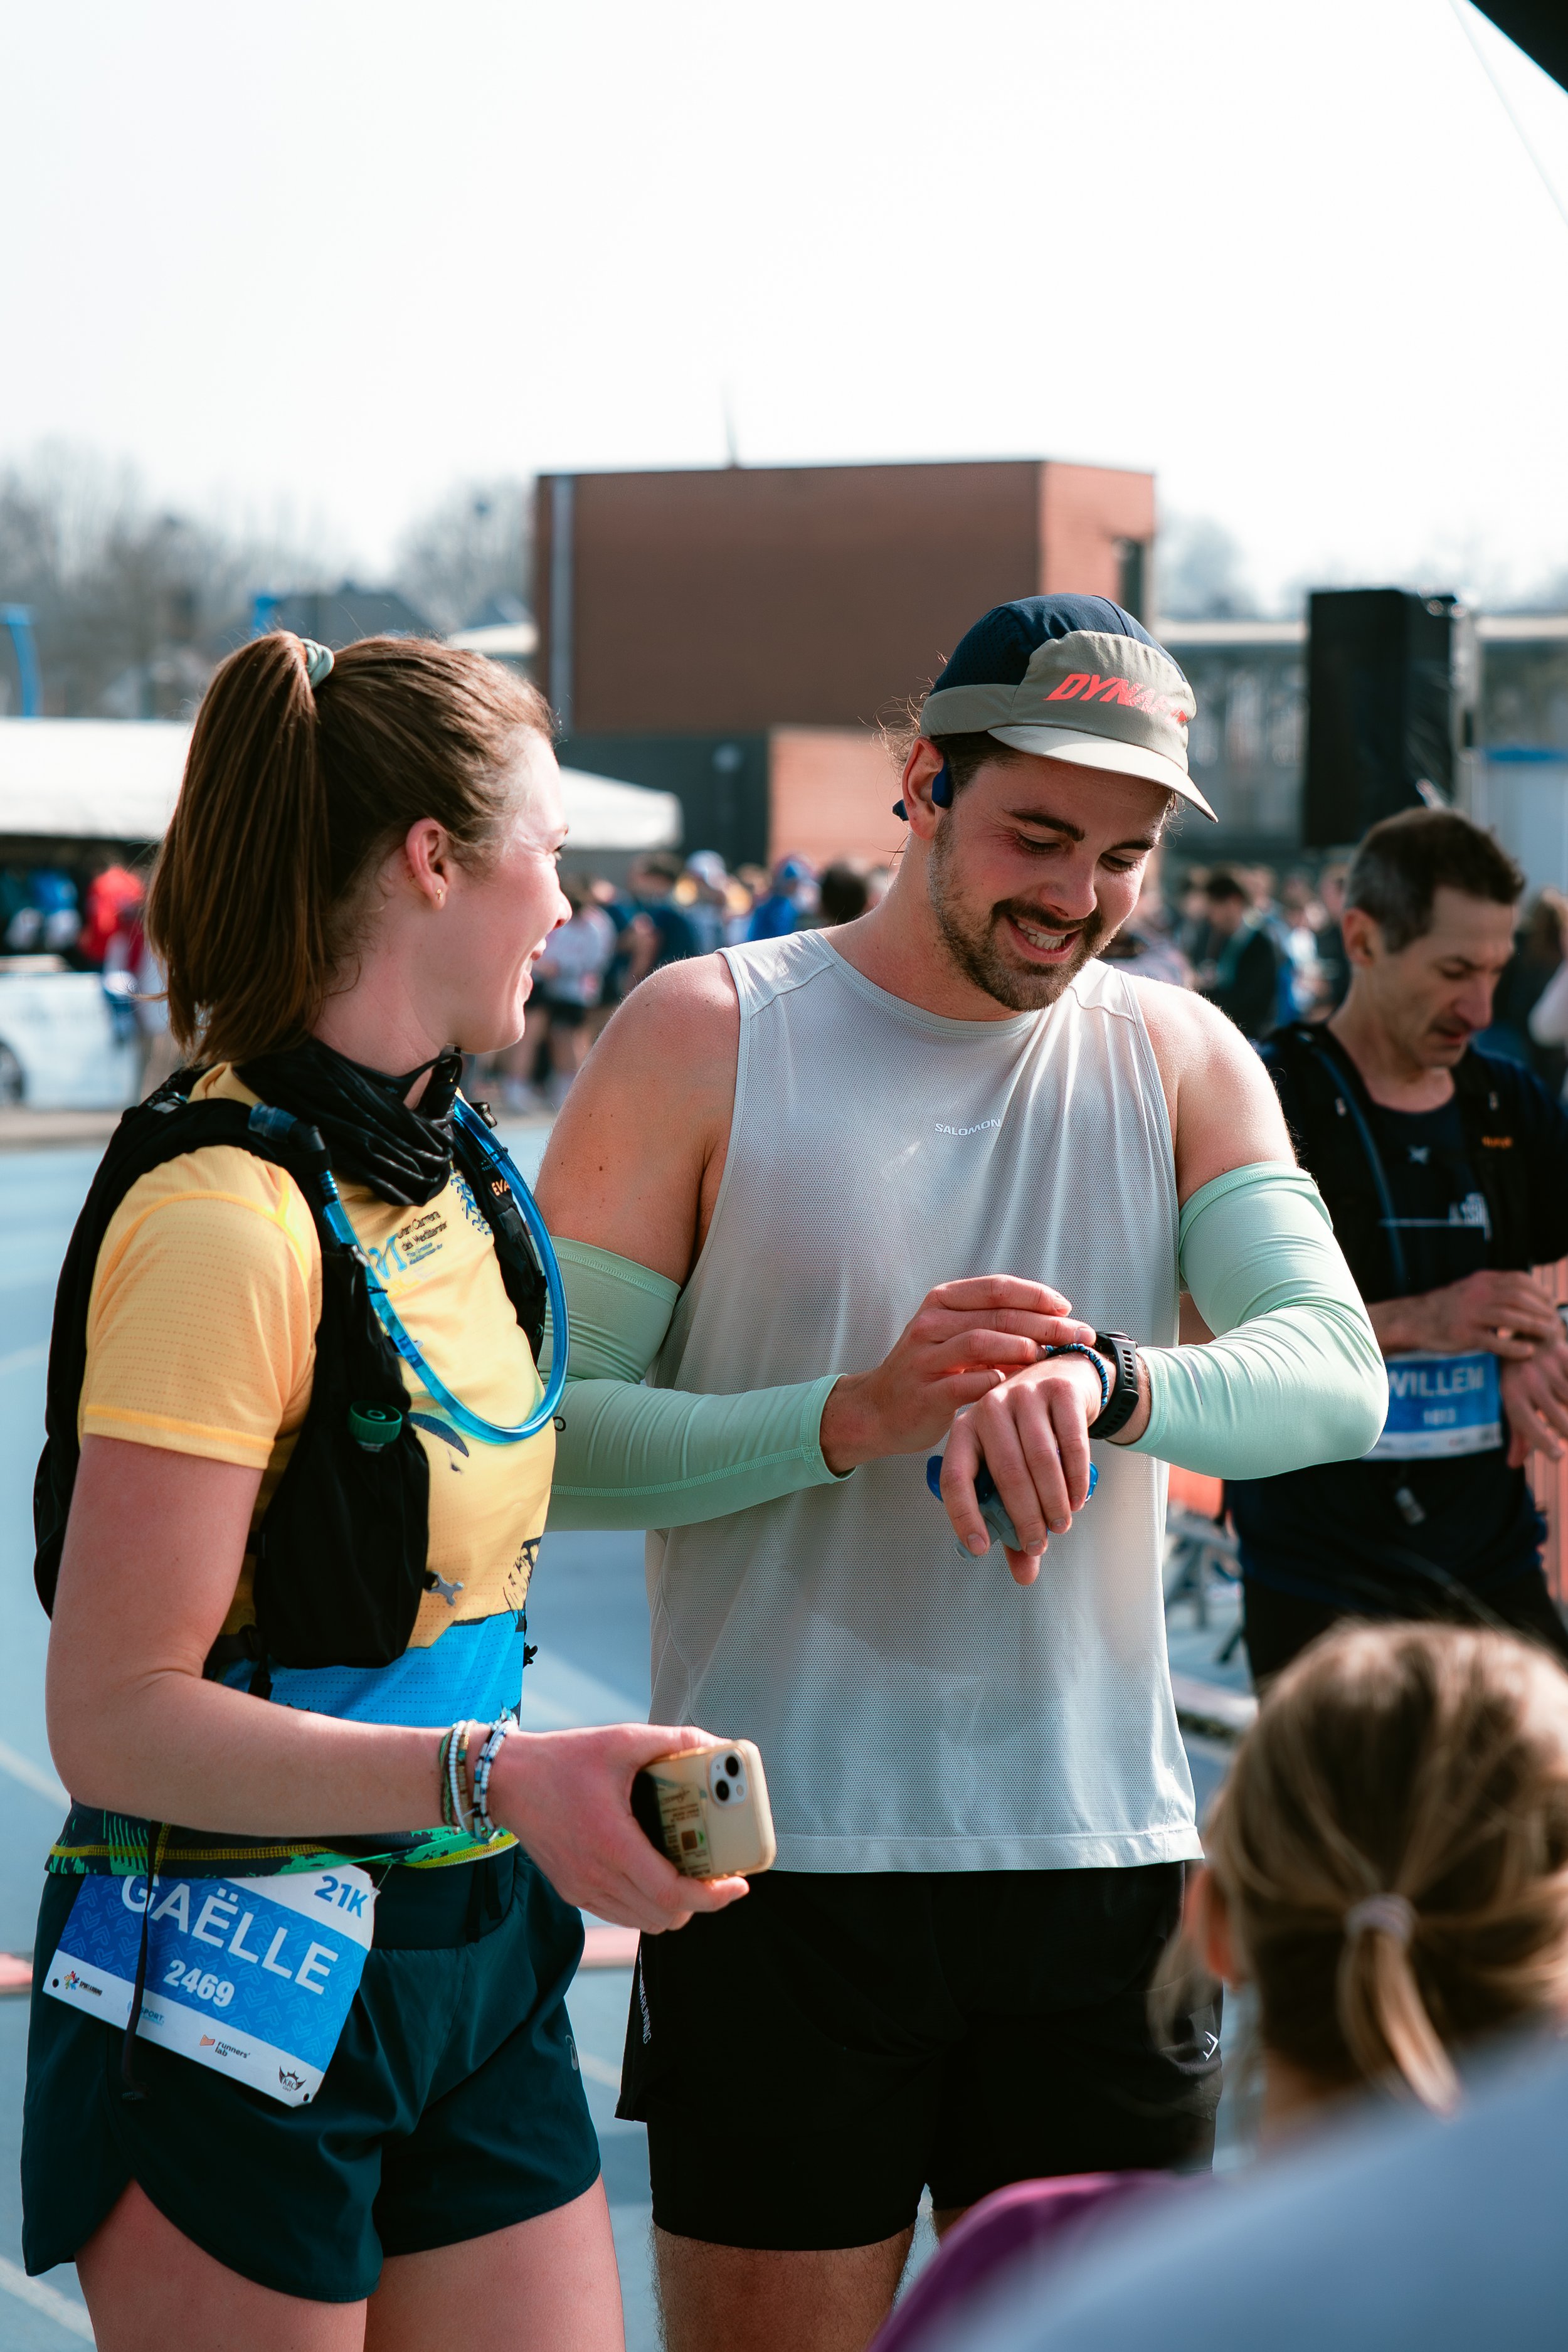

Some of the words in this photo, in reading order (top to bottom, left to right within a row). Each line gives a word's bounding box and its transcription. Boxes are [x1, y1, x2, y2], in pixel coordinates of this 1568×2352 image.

[935, 1118, 1002, 1136] SALOMON
[314, 1875, 369, 1919] 21K
[121, 1875, 339, 1996] GAËLLE
[162, 1959, 235, 2007] 2469
[640, 1996, 652, 2045] RUNNING
[215, 2045, 228, 2057] lab
[218, 2041, 251, 2058] runners'
